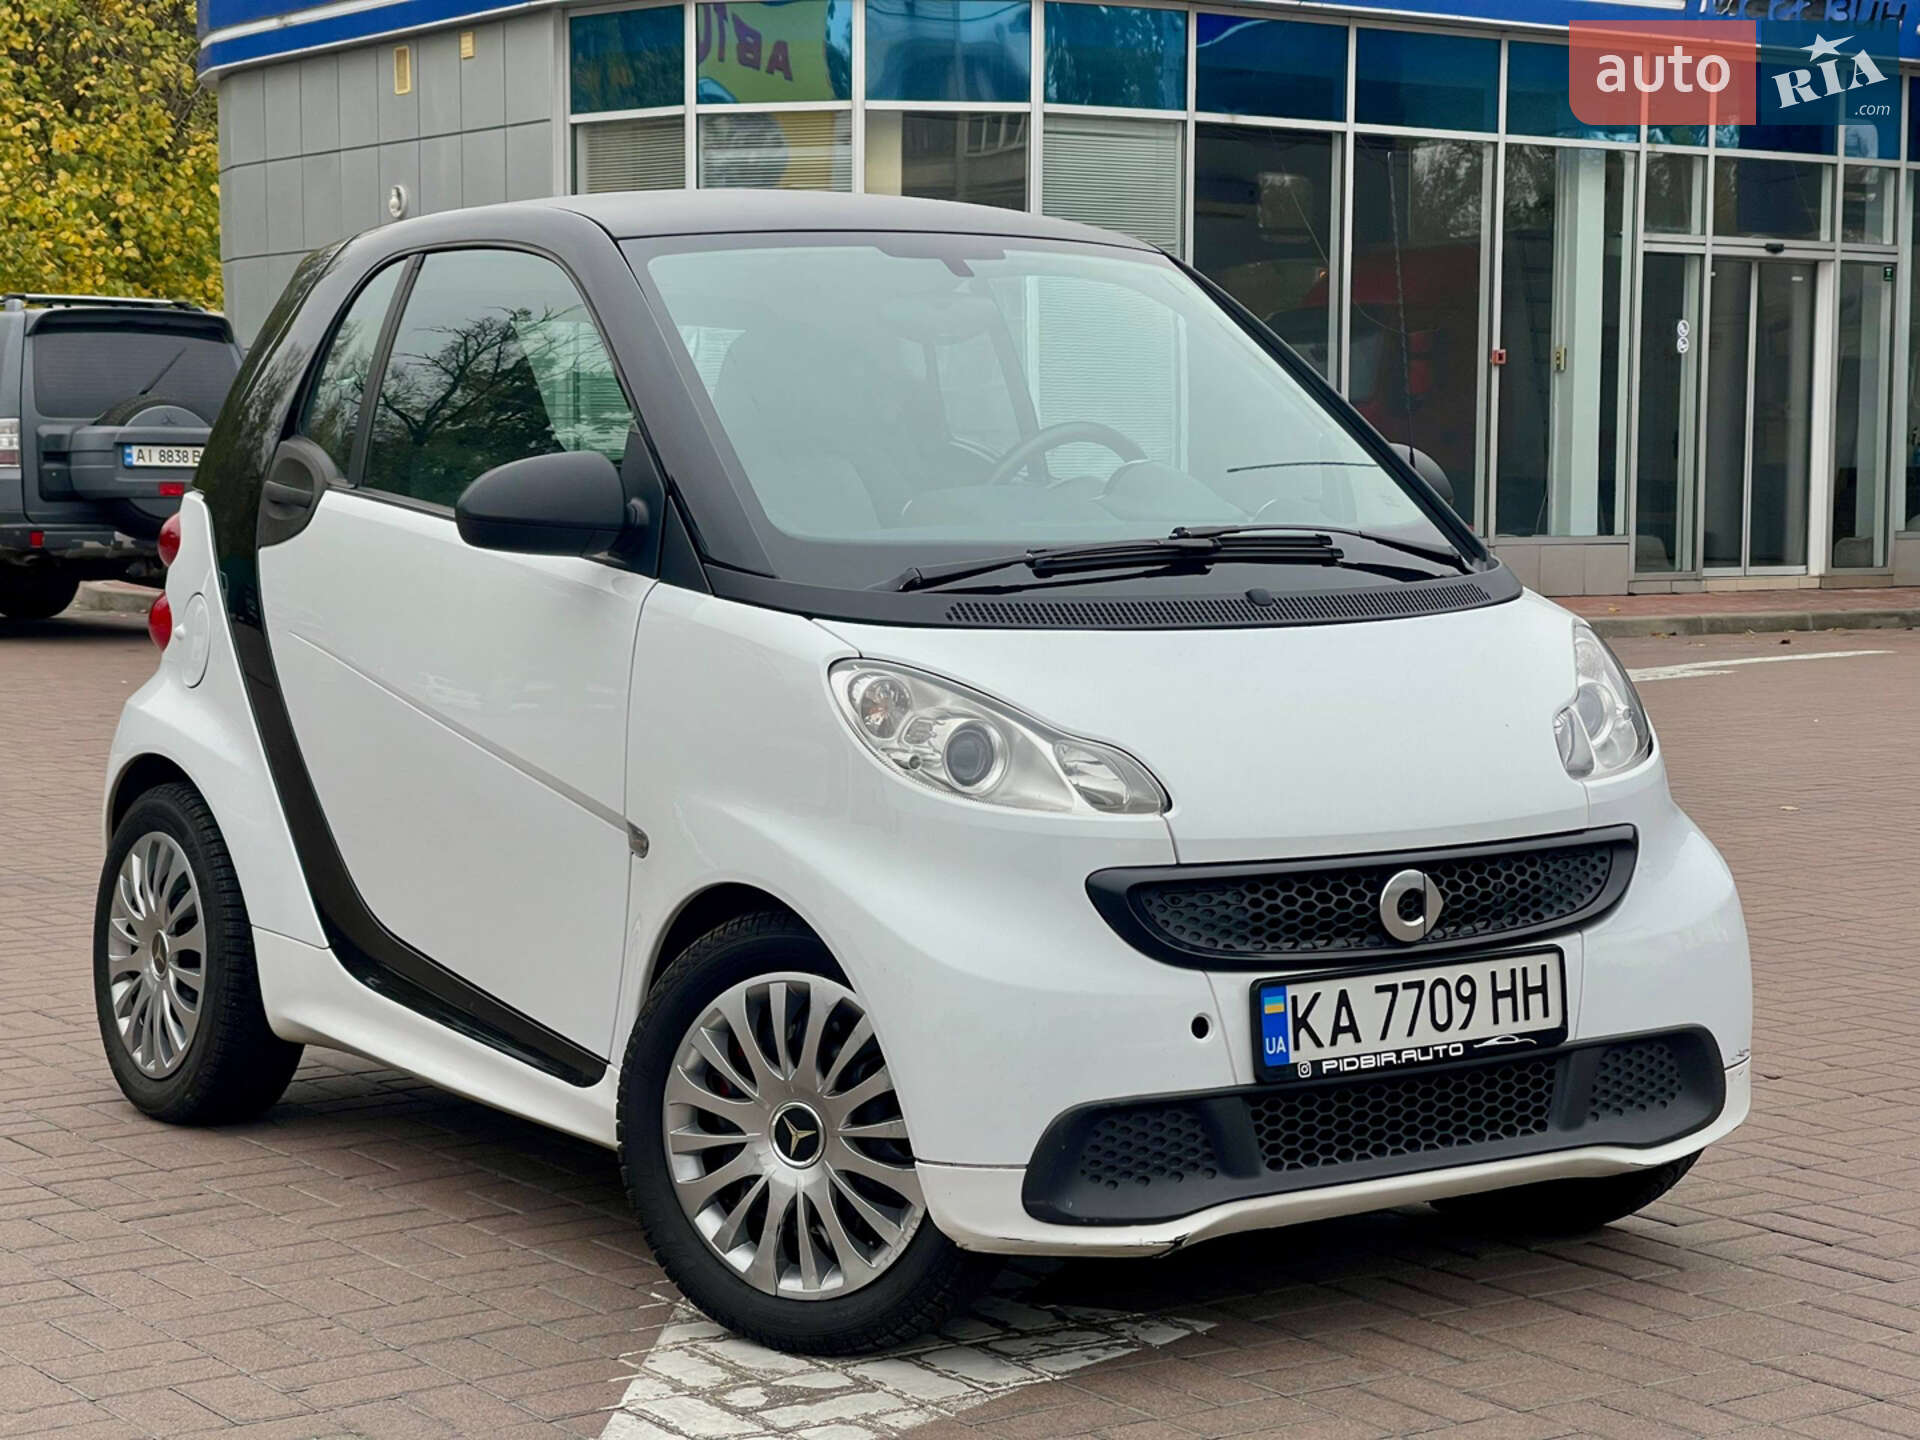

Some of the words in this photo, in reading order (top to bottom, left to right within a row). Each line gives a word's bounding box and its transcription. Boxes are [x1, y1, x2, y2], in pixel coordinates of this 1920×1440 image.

[136, 449, 152, 463] AI
[159, 449, 189, 463] 8838
[1290, 988, 1362, 1051] KA
[1374, 974, 1477, 1041] 7709
[1490, 964, 1550, 1026] HH
[1265, 1036, 1287, 1055] UA
[1322, 1043, 1464, 1074] PIDBIR.AUTO
